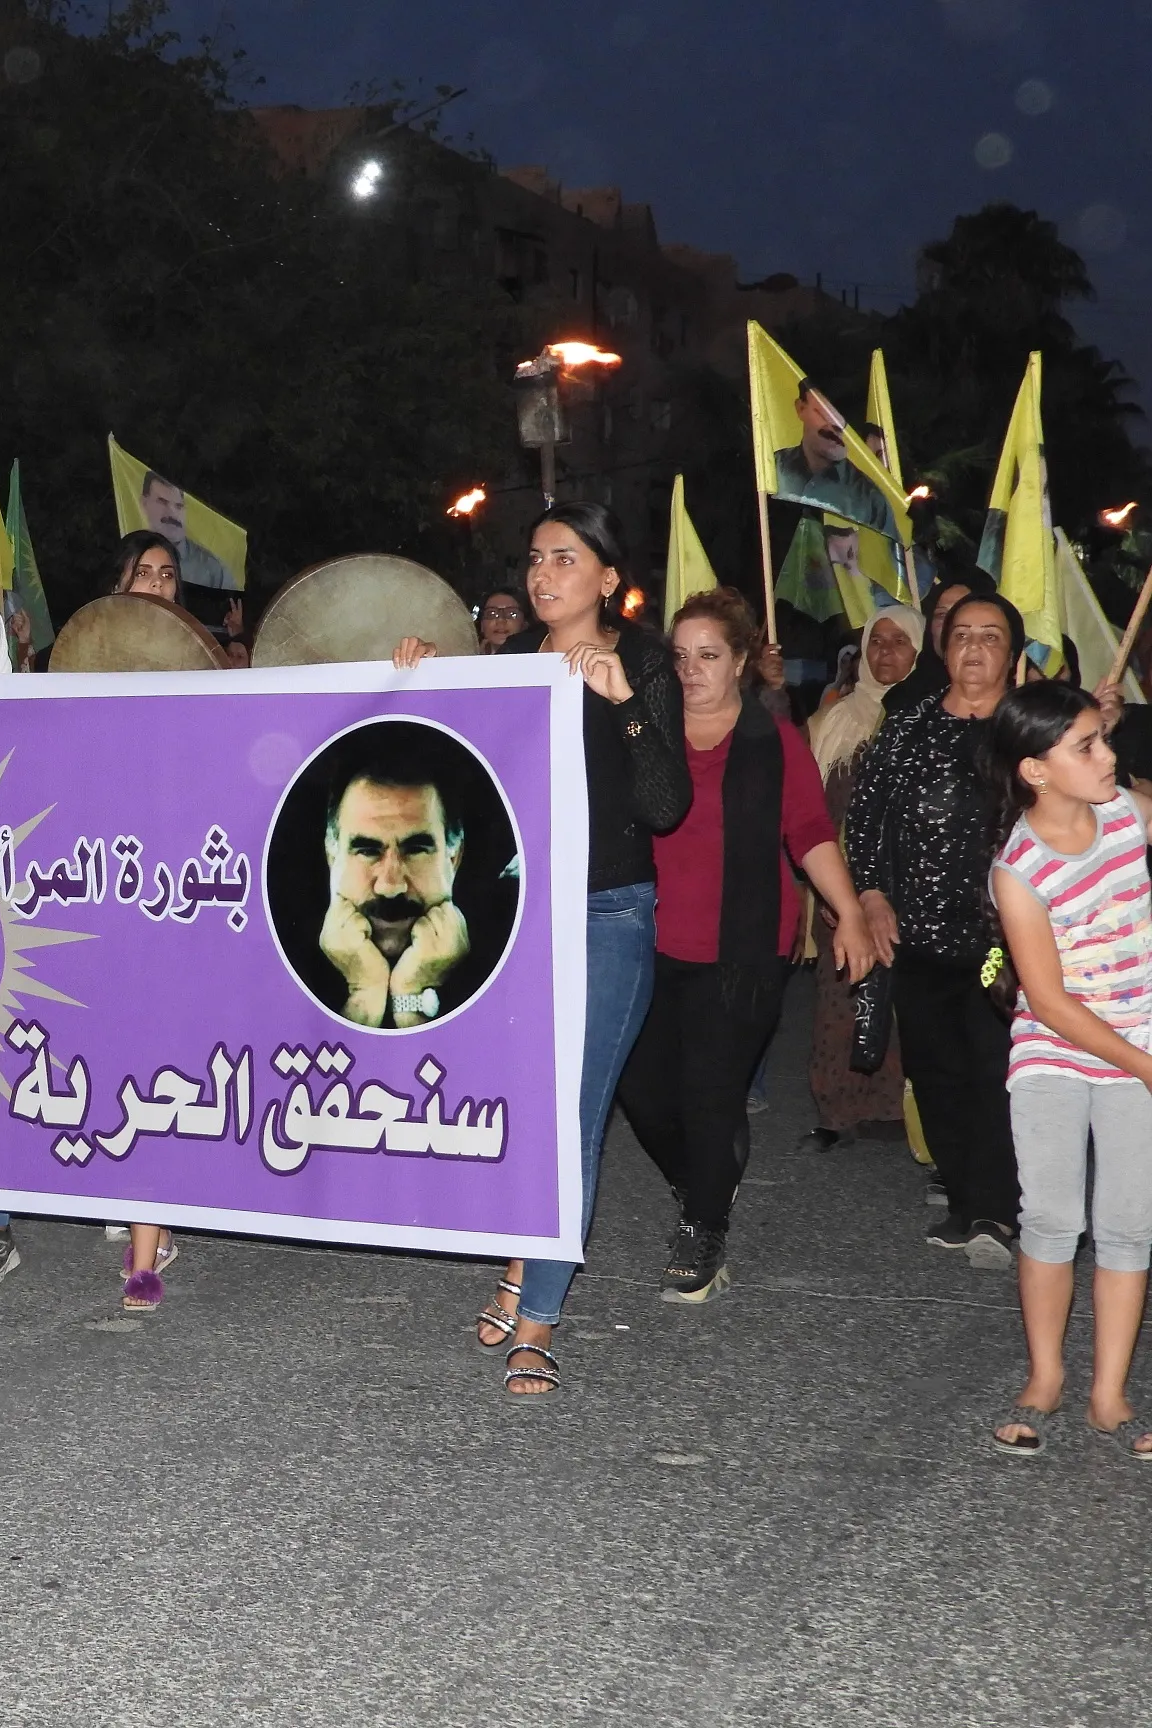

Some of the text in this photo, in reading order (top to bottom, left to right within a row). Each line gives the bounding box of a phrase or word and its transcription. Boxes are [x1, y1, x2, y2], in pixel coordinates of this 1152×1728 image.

[116, 824, 251, 932] بثورة
[7, 1019, 253, 1167] الحرية
[261, 1041, 510, 1176] سنحقق
